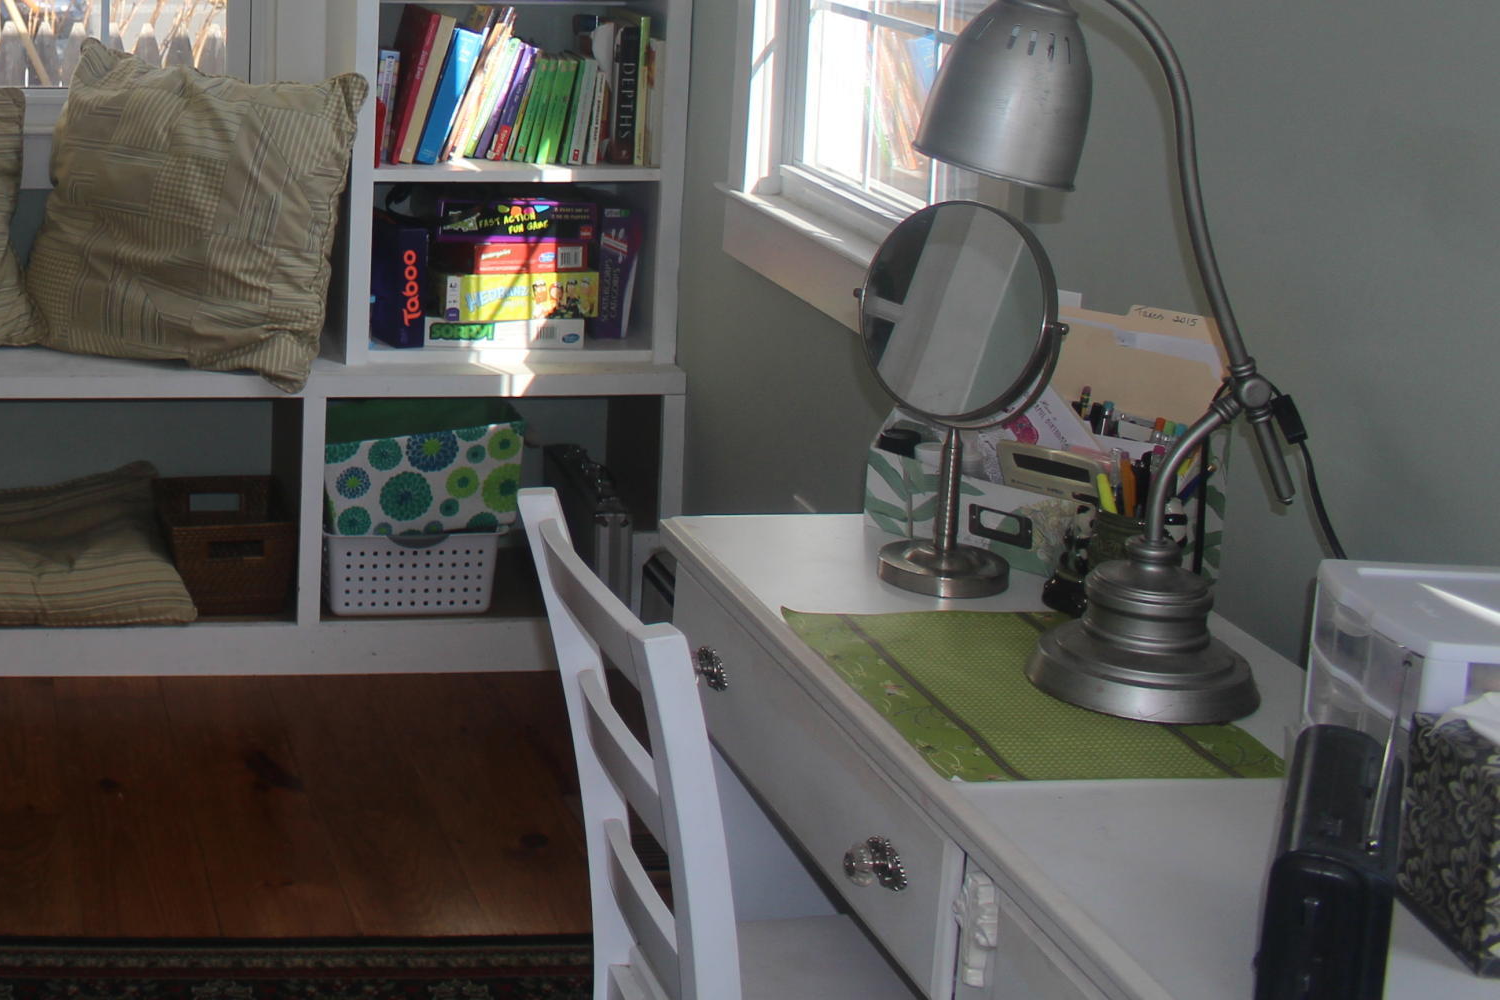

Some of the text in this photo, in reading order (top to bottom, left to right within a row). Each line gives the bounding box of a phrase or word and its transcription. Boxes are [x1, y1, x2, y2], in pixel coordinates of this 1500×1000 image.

[619, 62, 636, 139] DEPTHS
[478, 212, 536, 229] FAST ACTION
[508, 219, 549, 235] FUN GAME
[402, 249, 422, 327] Taboo
[1134, 306, 1198, 327] Taxes 2015
[429, 322, 495, 341] SORRY!
